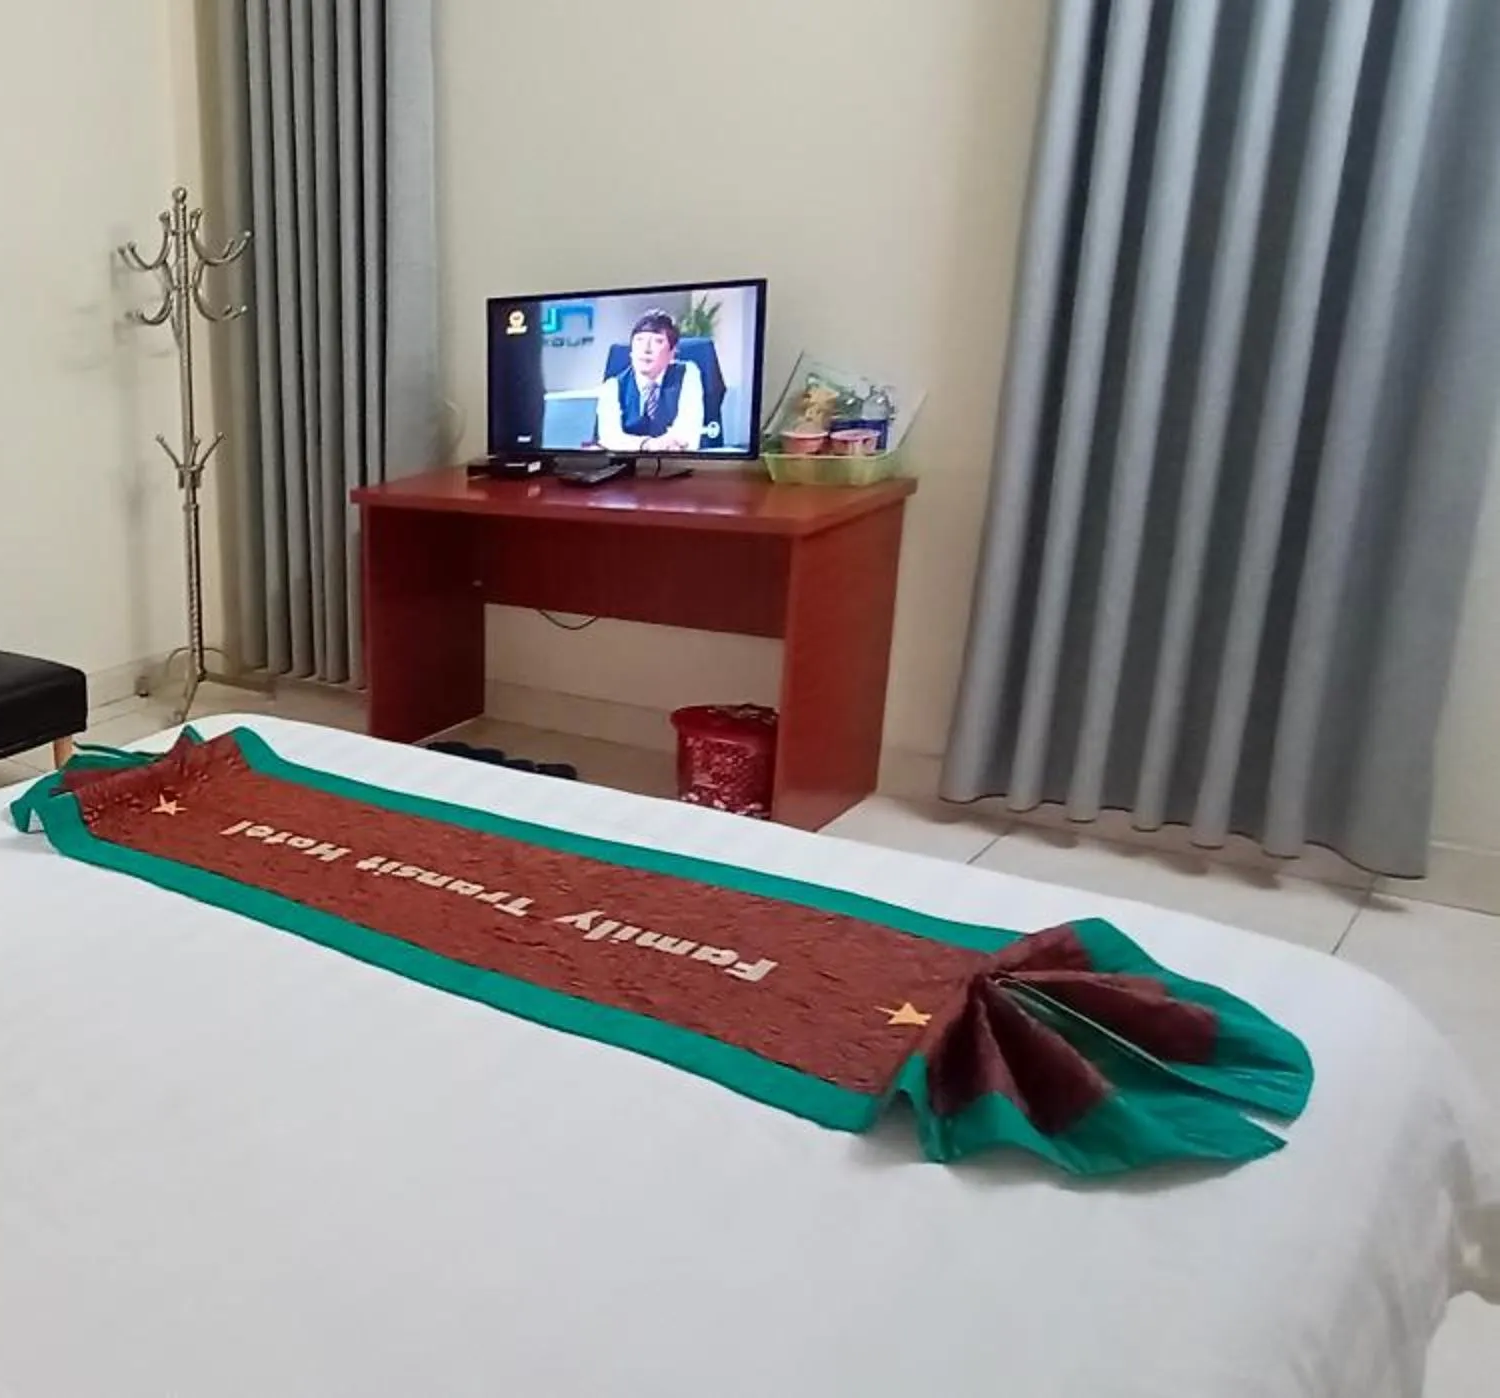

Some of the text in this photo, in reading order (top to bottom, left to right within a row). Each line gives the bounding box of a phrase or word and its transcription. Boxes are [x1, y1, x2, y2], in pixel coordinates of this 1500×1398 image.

[220, 820, 779, 983] Family Transit Hotel
